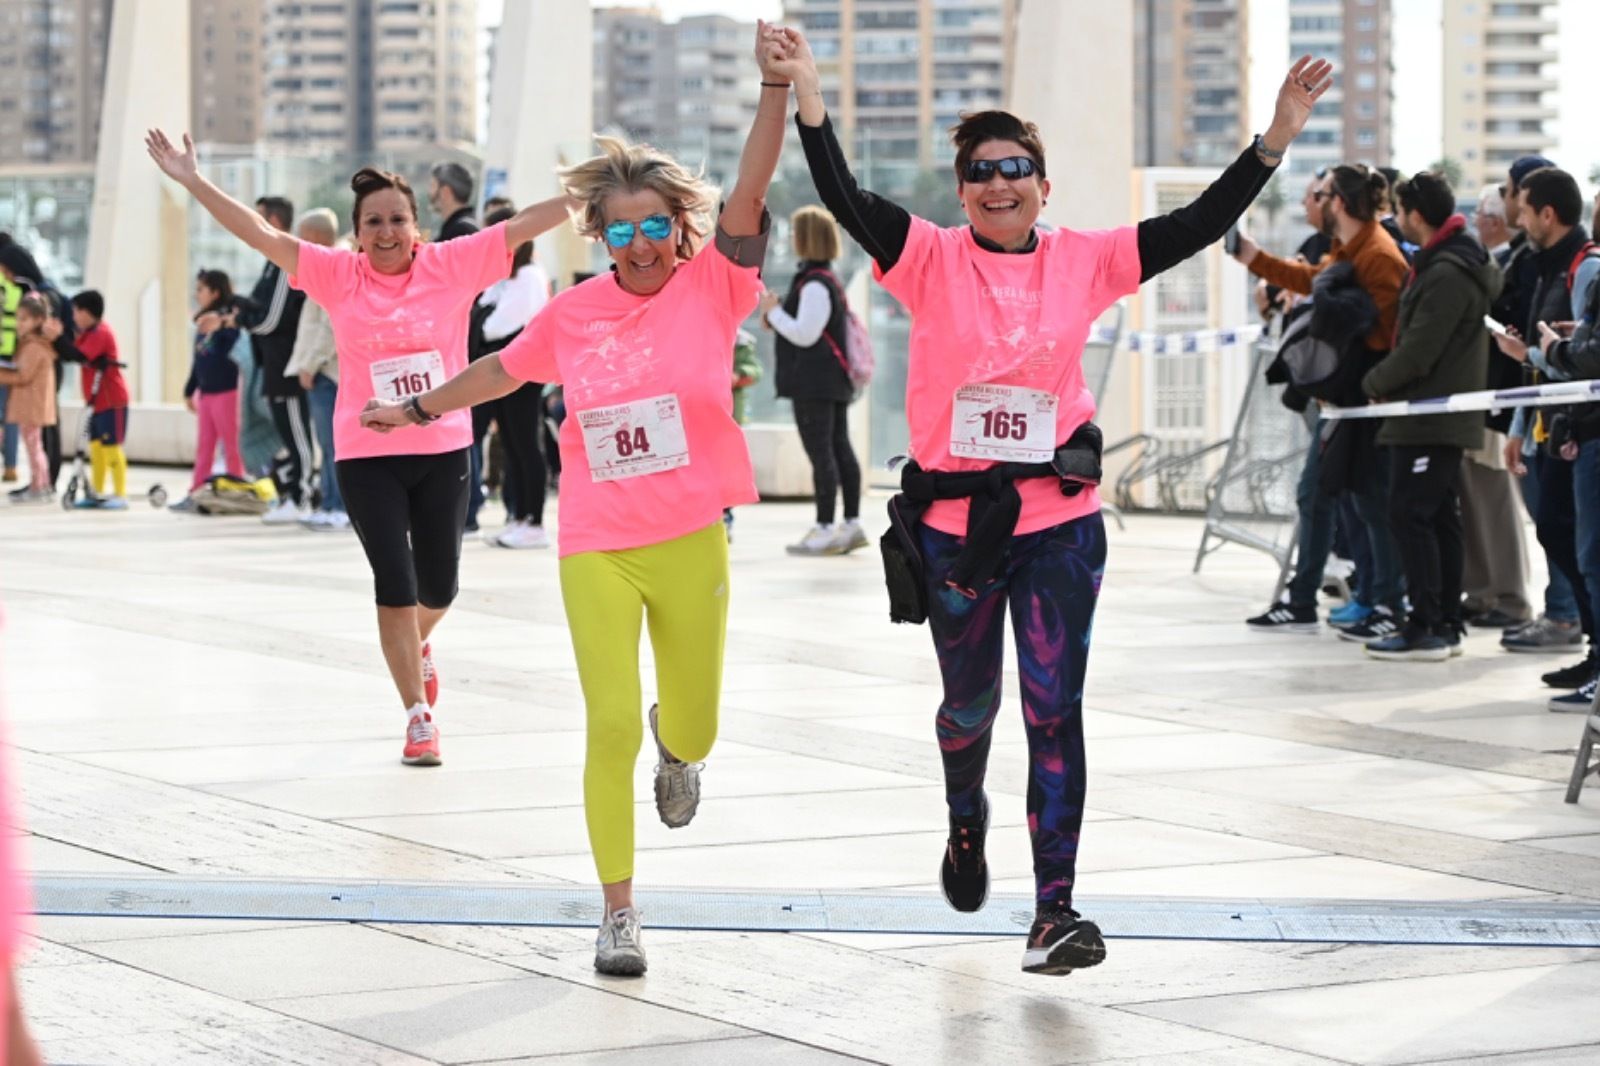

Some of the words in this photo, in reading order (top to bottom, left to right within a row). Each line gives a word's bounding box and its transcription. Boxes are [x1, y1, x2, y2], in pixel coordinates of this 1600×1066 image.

[391, 371, 432, 397] 1161
[981, 409, 1027, 441] 165
[615, 426, 650, 457] 84
